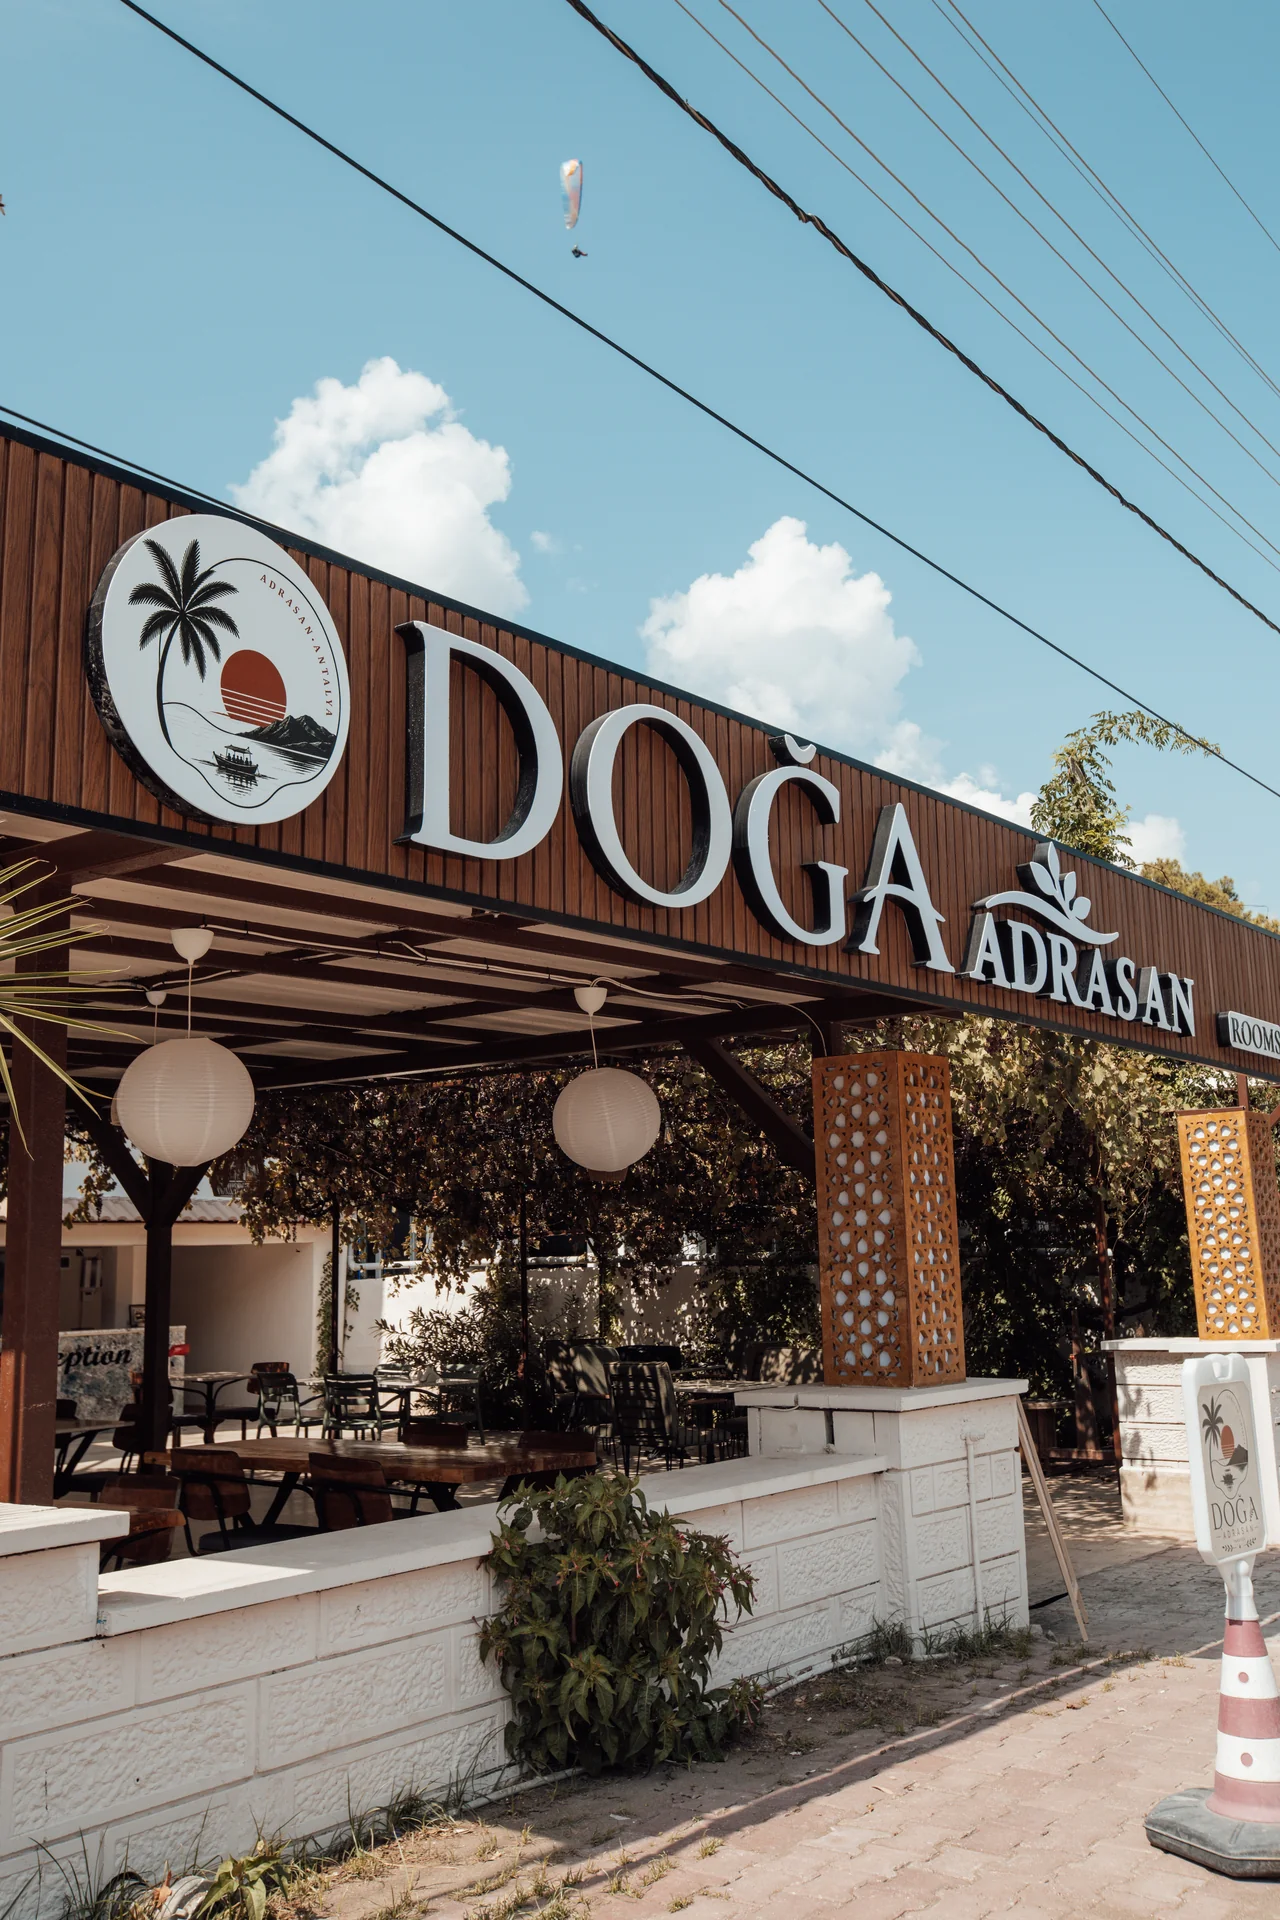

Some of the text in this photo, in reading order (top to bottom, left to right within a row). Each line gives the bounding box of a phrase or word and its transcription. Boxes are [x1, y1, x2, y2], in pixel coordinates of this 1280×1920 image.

[260, 574, 333, 716] ADRASAN ANTALYA
[409, 619, 956, 974] DOĞA
[967, 912, 1196, 1037] ADRASAN
[1231, 1017, 1280, 1054] ROOMS
[1211, 1494, 1259, 1530] DOĞA
[1223, 1525, 1254, 1539] ADRASAN
